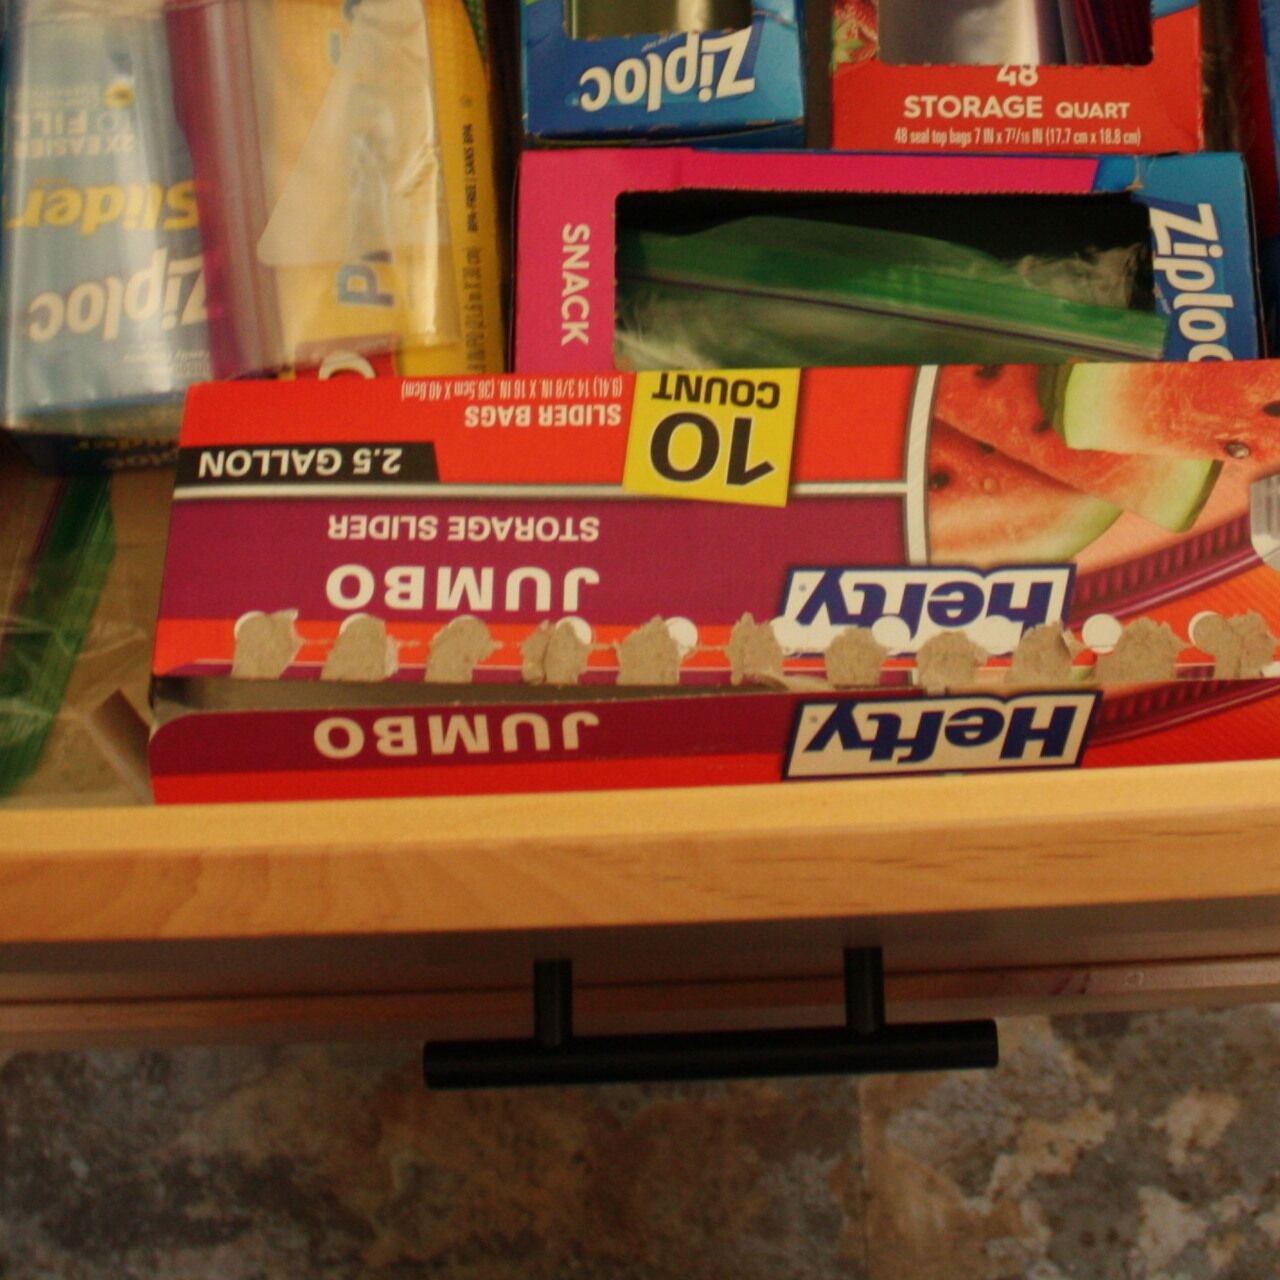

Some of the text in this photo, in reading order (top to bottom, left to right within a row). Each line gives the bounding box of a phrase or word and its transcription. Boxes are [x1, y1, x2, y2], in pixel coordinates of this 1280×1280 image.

[579, 25, 756, 113] Ziploc
[996, 64, 1039, 88] 48
[903, 95, 1131, 120] STORAGE QUART
[894, 127, 908, 144] 48
[910, 128, 929, 143] seal
[930, 129, 946, 148] top
[949, 127, 971, 148] bags
[1073, 131, 1089, 144] cm
[6, 179, 198, 236] Slider
[28, 246, 208, 344] Ziploc
[561, 223, 591, 346] SNACK
[1148, 203, 1234, 362] Ziploc
[578, 377, 590, 398] 14
[652, 372, 781, 411] COUNT
[464, 403, 622, 428] SLIDER BAGS
[198, 448, 343, 477] GALLON
[352, 446, 403, 475] 2.5
[649, 412, 774, 487] 10
[327, 514, 600, 542] STORAGE SLIDER
[325, 563, 600, 612] JUMBO
[313, 710, 600, 759] JUMBO
[800, 700, 1077, 764] Hefty
